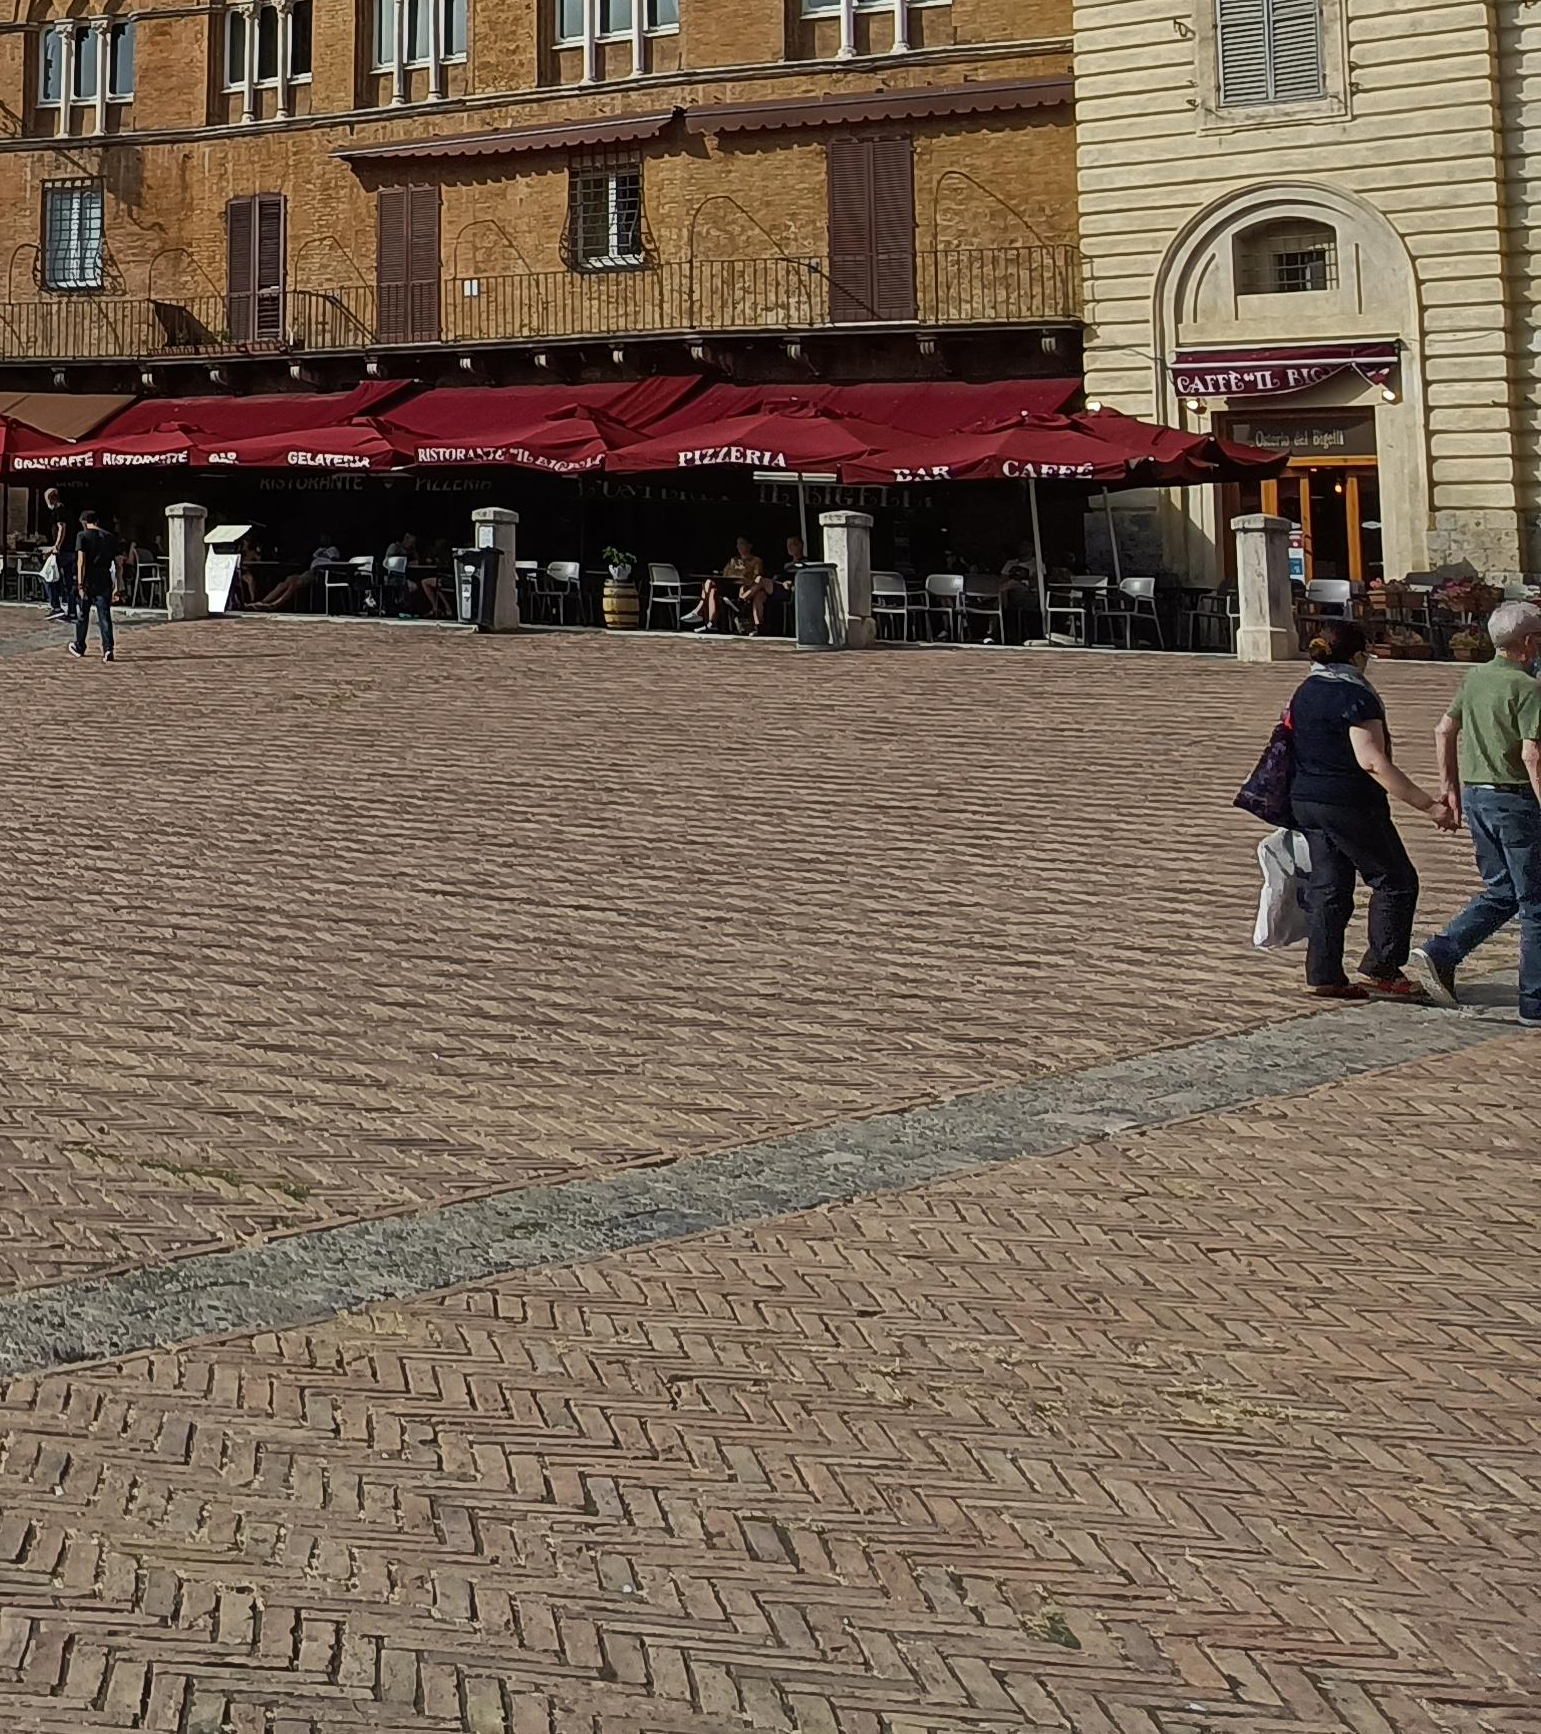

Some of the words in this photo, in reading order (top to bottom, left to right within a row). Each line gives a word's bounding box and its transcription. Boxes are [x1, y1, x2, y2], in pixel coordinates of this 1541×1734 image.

[1176, 370, 1245, 393] CAFFÈ
[417, 447, 507, 462] RISTORANTE
[677, 446, 787, 468] PIZZERIA
[893, 465, 951, 483] BAR
